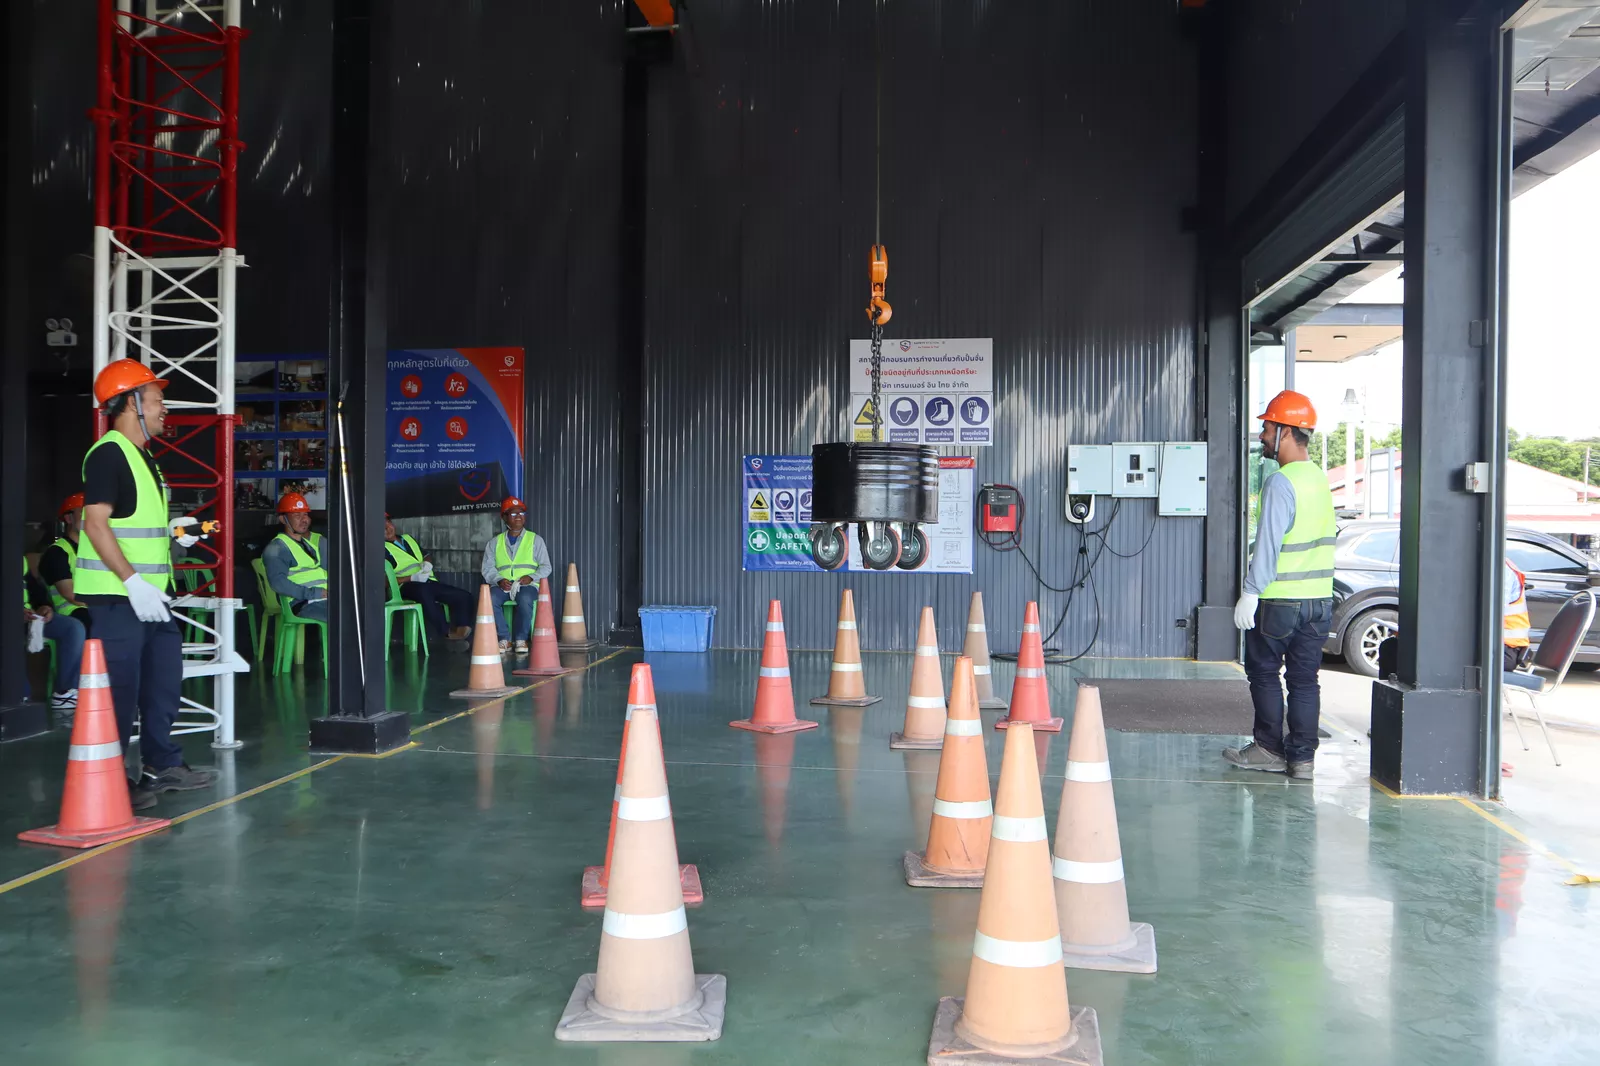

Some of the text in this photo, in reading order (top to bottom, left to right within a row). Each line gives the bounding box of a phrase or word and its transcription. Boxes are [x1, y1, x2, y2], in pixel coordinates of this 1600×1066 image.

[858, 353, 984, 363] สถาฝึกอบรมการทำงานเกี่ยวกับปั้นจั่น
[475, 501, 501, 510] STATION
[775, 542, 810, 551] SAFETY
